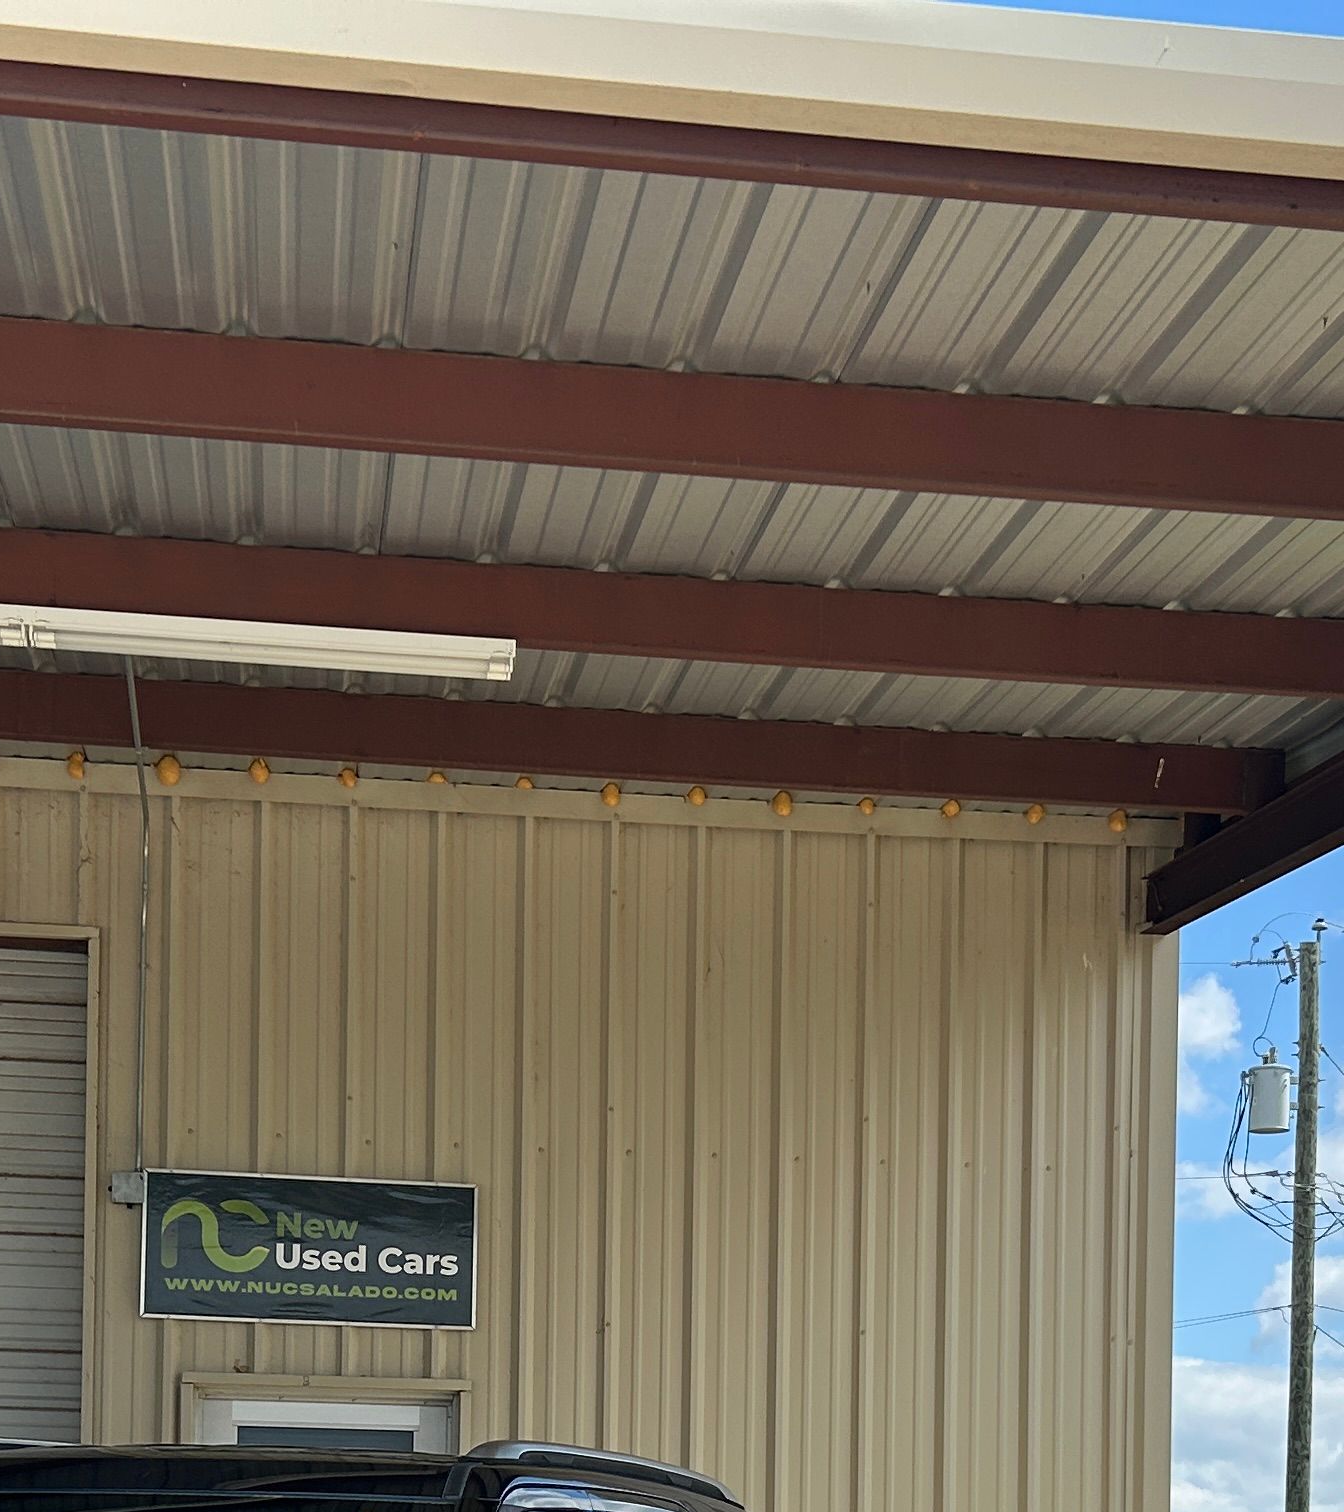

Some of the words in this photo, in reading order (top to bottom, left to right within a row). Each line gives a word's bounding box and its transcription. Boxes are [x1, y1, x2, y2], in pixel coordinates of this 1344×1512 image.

[275, 1211, 359, 1240] New
[275, 1243, 367, 1273] Used
[377, 1247, 459, 1276] Cars
[164, 1277, 458, 1301] WWW.NUCSALADO.COM
